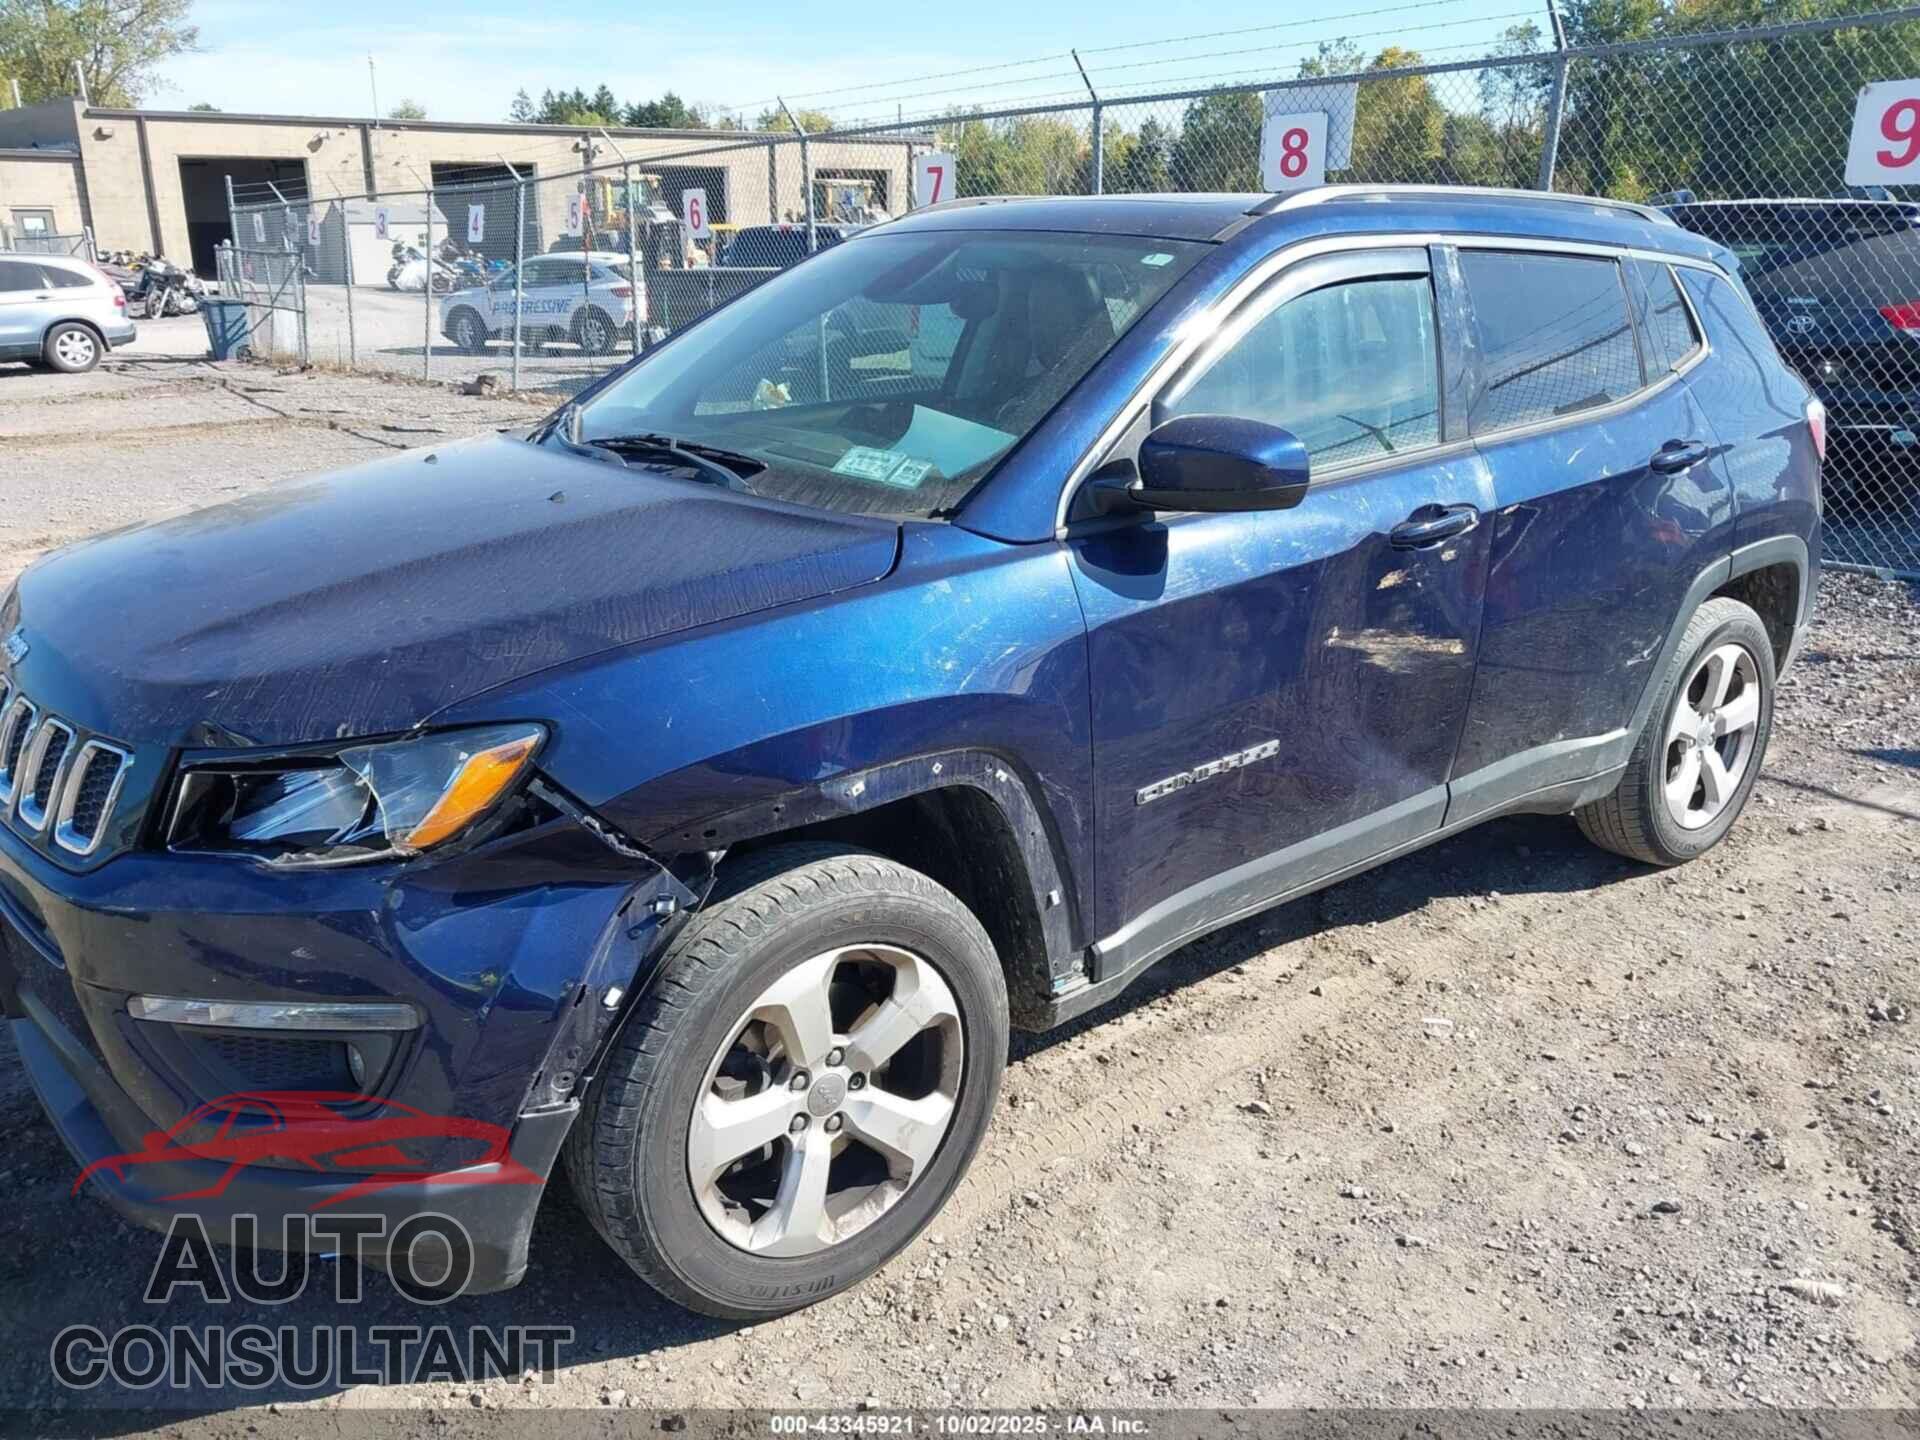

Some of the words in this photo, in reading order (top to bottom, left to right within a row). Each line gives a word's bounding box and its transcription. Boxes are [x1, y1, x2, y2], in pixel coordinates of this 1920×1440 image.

[1876, 98, 1920, 169] 9
[1280, 127, 1309, 178] 8
[927, 166, 943, 205] 7
[379, 213, 386, 234] 3
[471, 212, 480, 234] 4
[570, 202, 578, 229] 5
[690, 198, 701, 230] 6
[1136, 738, 1281, 806] COMPASS
